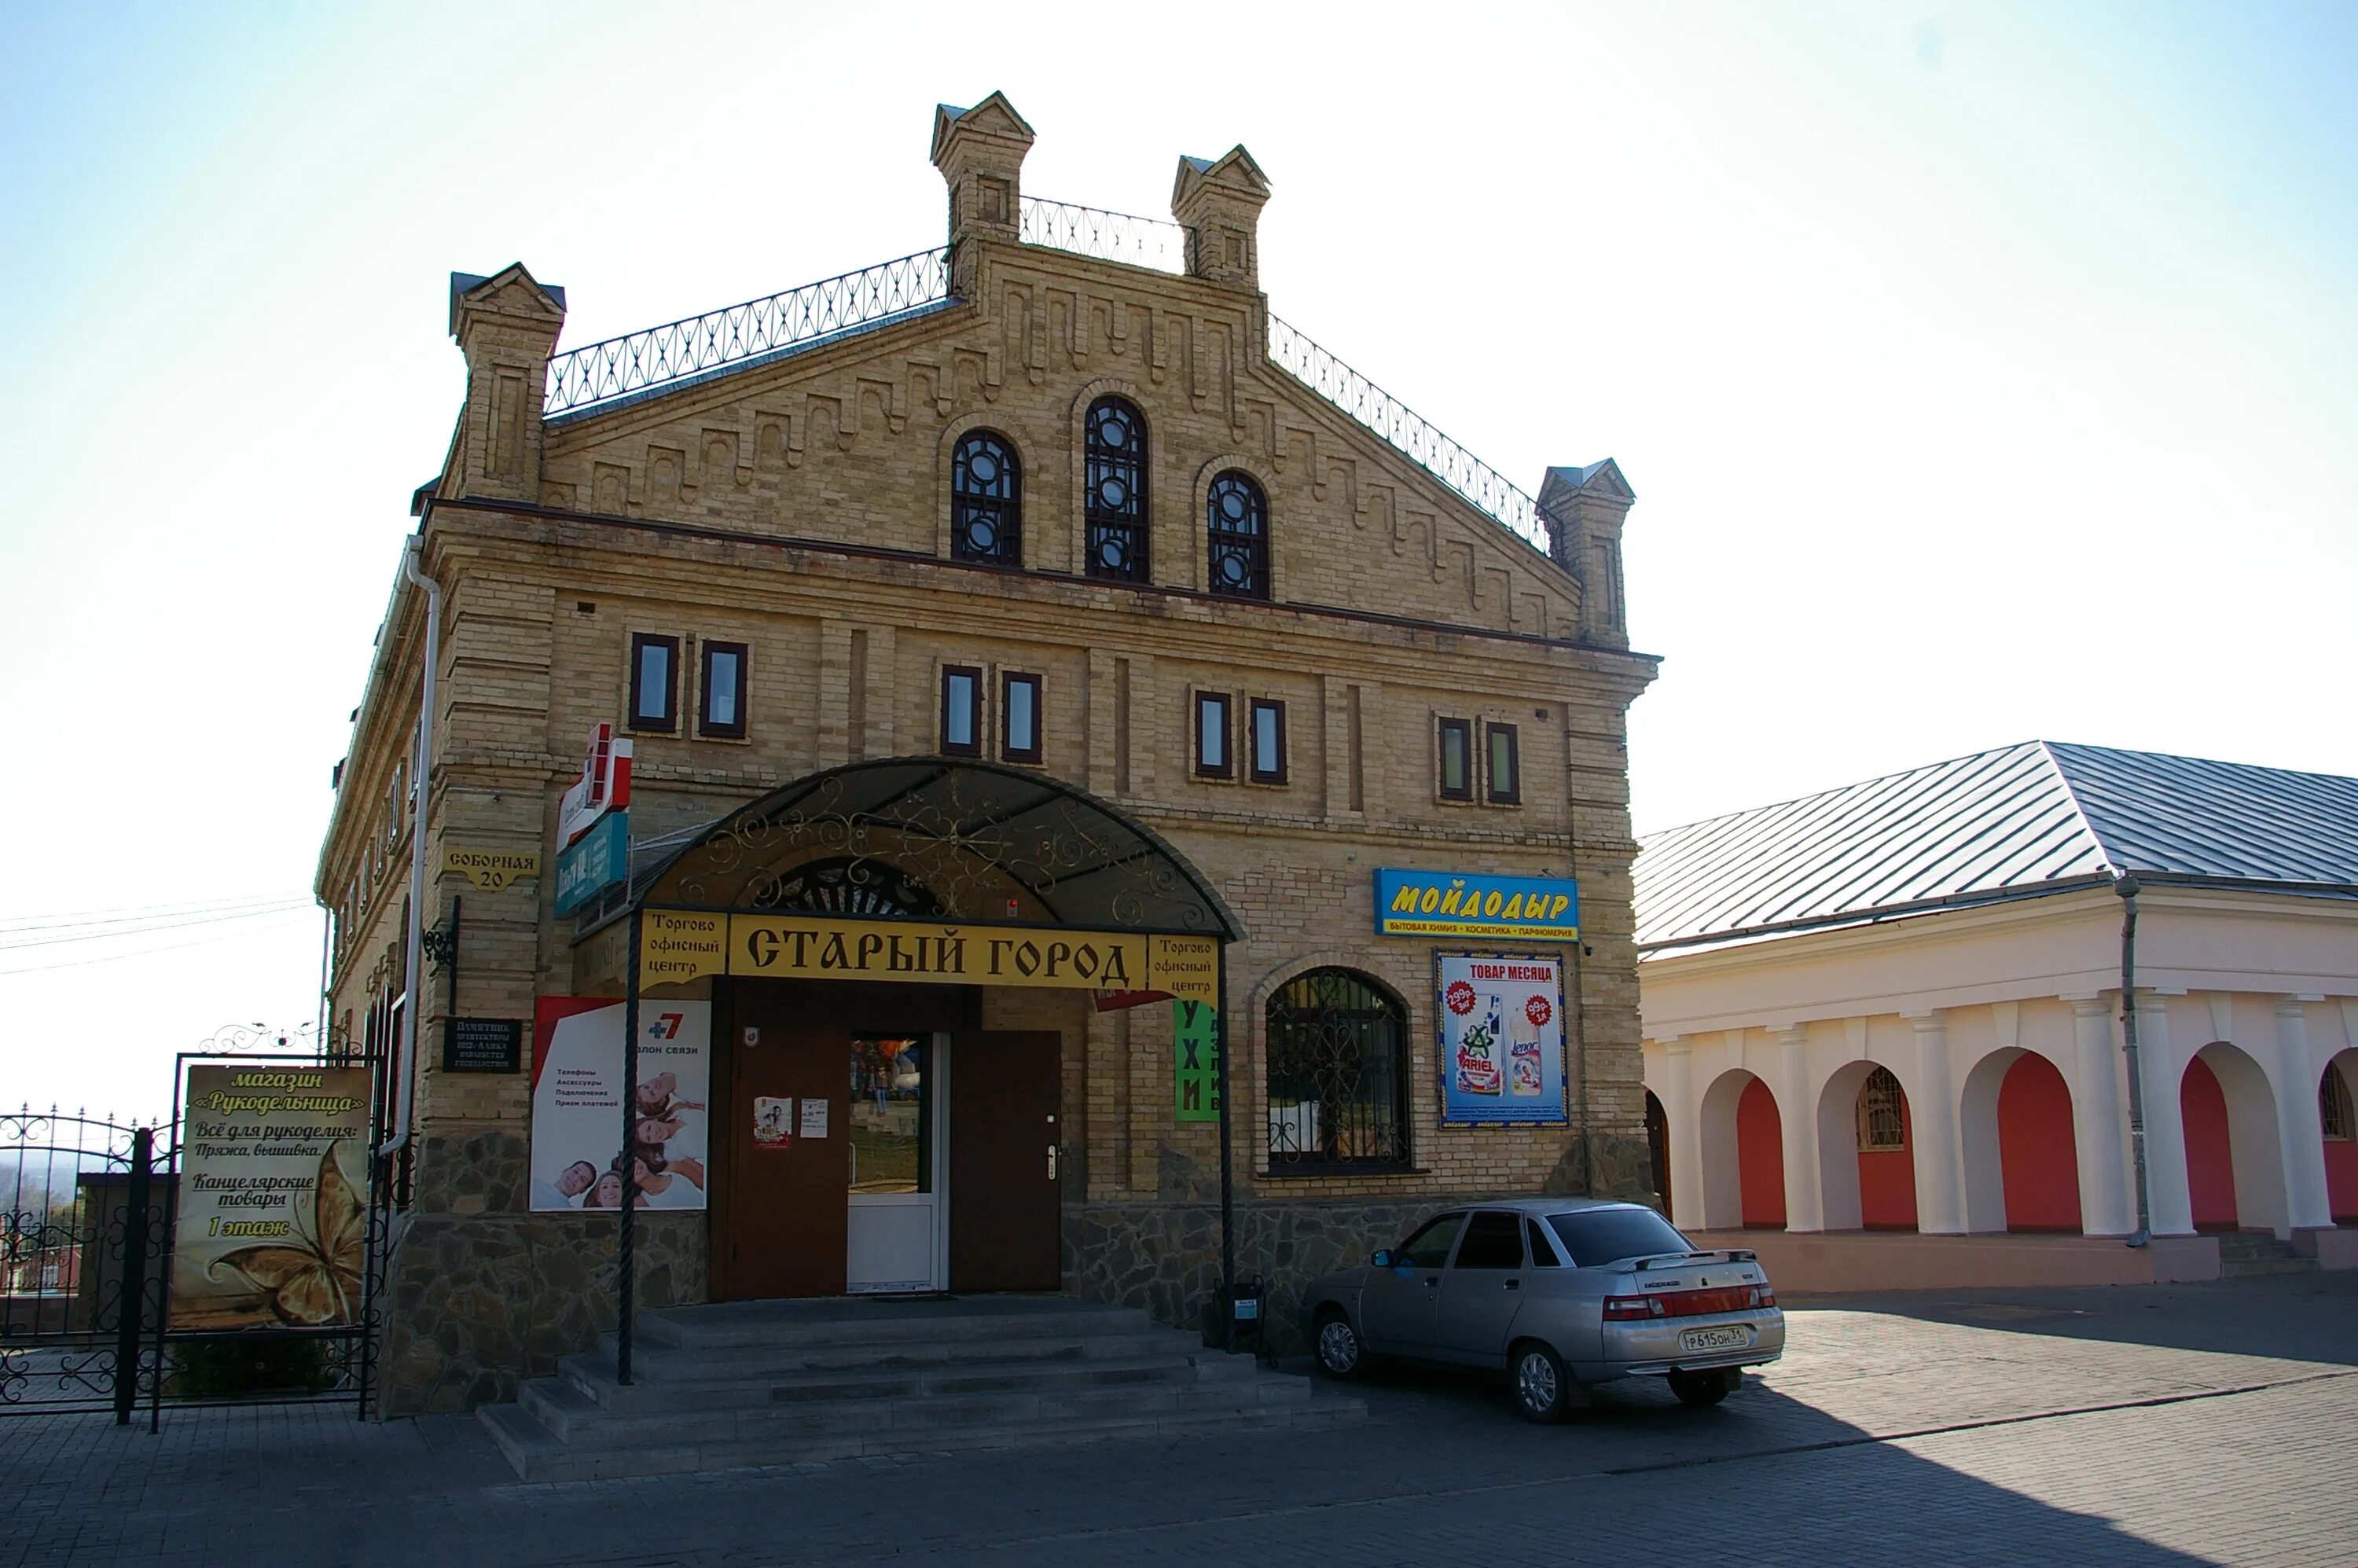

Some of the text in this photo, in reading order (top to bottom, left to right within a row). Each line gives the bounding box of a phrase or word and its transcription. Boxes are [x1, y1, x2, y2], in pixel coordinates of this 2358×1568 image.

[450, 852, 534, 870] СОБОРНАЯ
[480, 872, 503, 887] 20
[1390, 877, 1570, 920] МОЙДОДЫР
[652, 914, 715, 931] Торгово
[1390, 923, 1572, 938] БЫТОВАЯ ХИМИЯ КОСМЕТИКА ПАРФЮМЕРИЯ
[650, 937, 719, 953] офисный
[1160, 939, 1211, 956] Торгово
[747, 928, 1130, 988] СТАРЫЙ ГОРОД
[648, 959, 696, 976] центр
[1155, 959, 1211, 975] офисный
[1470, 965, 1505, 979] ТОВАР
[1508, 966, 1552, 982] МЕСЯЦА
[1172, 982, 1210, 995] центр
[1512, 1039, 1538, 1056] Lenor
[1463, 1059, 1495, 1072] ARIEL
[231, 1072, 322, 1092] магазин
[195, 1091, 365, 1115] «Рукодельница»
[195, 1122, 357, 1141] Всё для рукоделия:
[195, 1143, 321, 1158] Пряжа, вышивка.
[193, 1173, 314, 1190] Канцелярские
[219, 1192, 286, 1209] товары
[209, 1216, 291, 1237] 1 этаж
